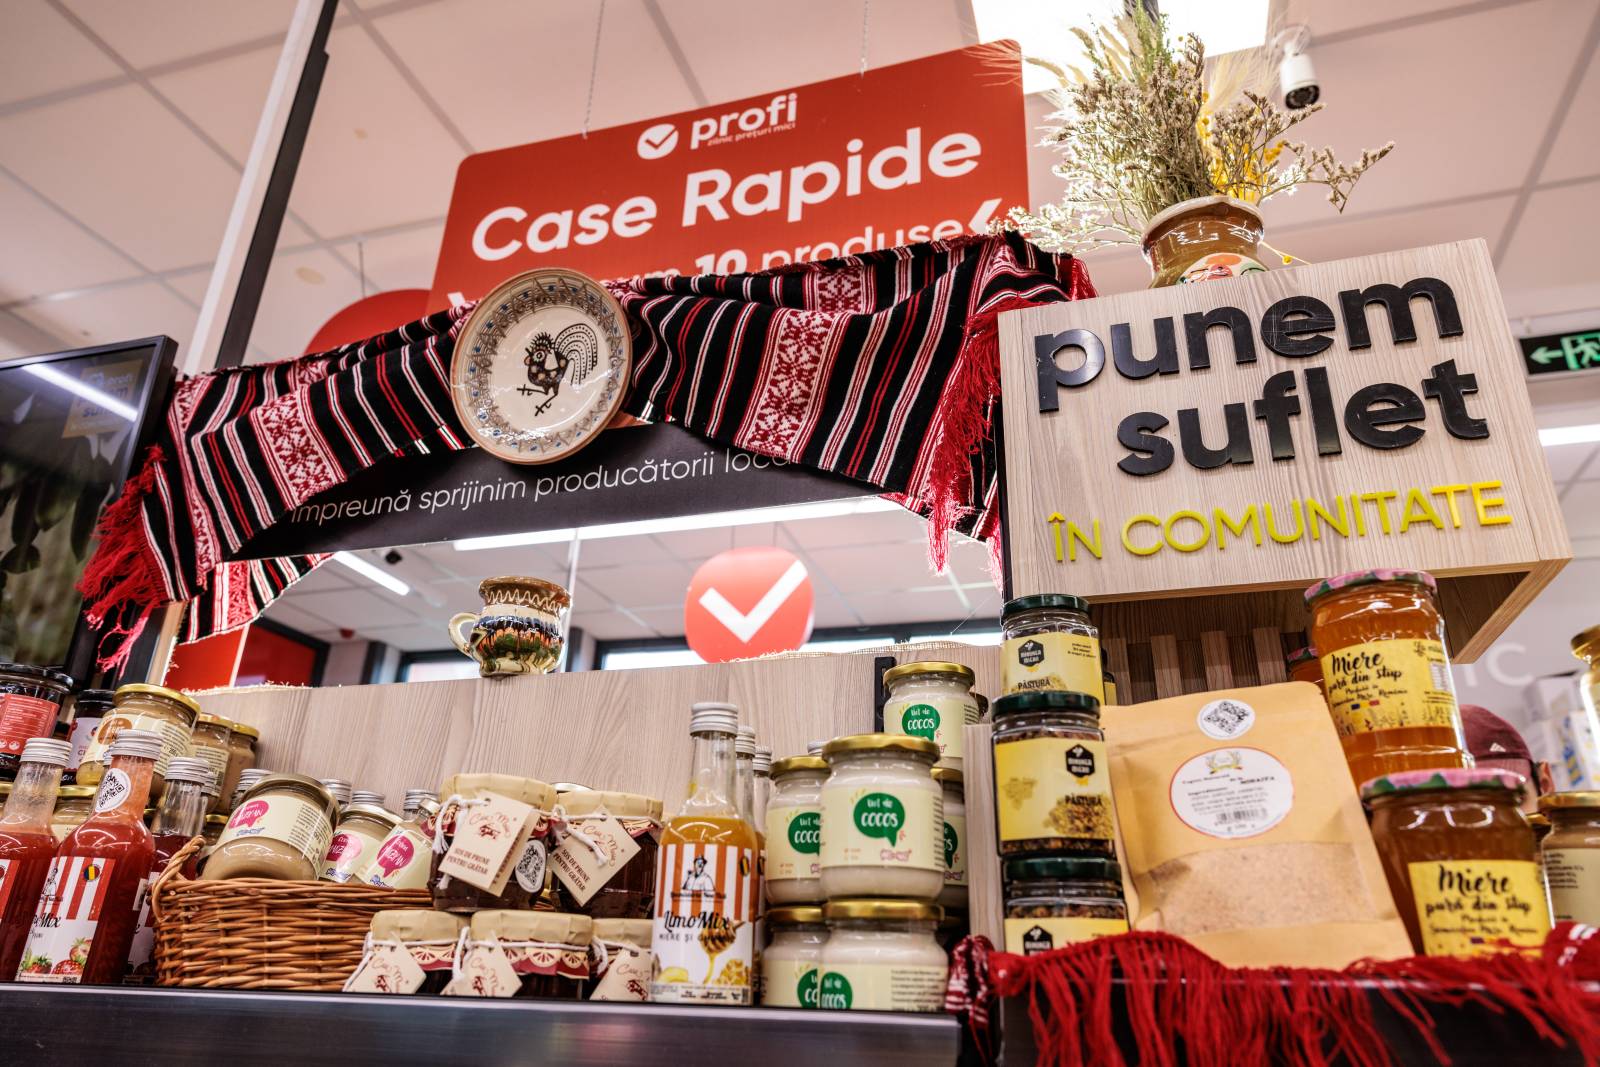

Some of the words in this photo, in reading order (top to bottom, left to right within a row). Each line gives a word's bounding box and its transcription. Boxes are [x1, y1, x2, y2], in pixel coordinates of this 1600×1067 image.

[690, 92, 798, 150] profi
[773, 122, 796, 134] mici
[471, 193, 658, 262] Case
[681, 126, 982, 228] Rapide
[694, 249, 748, 275] 10
[759, 219, 964, 269] produse
[1033, 276, 1465, 413] punem
[1116, 358, 1490, 477] suflet
[418, 477, 528, 513] sprijinim
[534, 453, 715, 502] producătorii
[724, 448, 792, 473] loca
[1048, 511, 1104, 562] ÎN
[1121, 479, 1514, 556] COMUNITATE
[1331, 651, 1384, 676] Miere
[1351, 670, 1370, 685] din
[1376, 664, 1402, 682] stup
[907, 718, 935, 731] COCOS
[860, 812, 899, 828] COCOS
[794, 830, 820, 845] COCO
[471, 853, 491, 866] PRUNE
[553, 852, 571, 873] PENTRU
[568, 870, 586, 891] GRĂTAR
[561, 848, 570, 860] SOS
[574, 865, 591, 882] PRUNE
[1437, 864, 1510, 896] Miere
[1472, 896, 1497, 911] din
[1505, 896, 1531, 915] stup
[659, 933, 681, 942] MIERE
